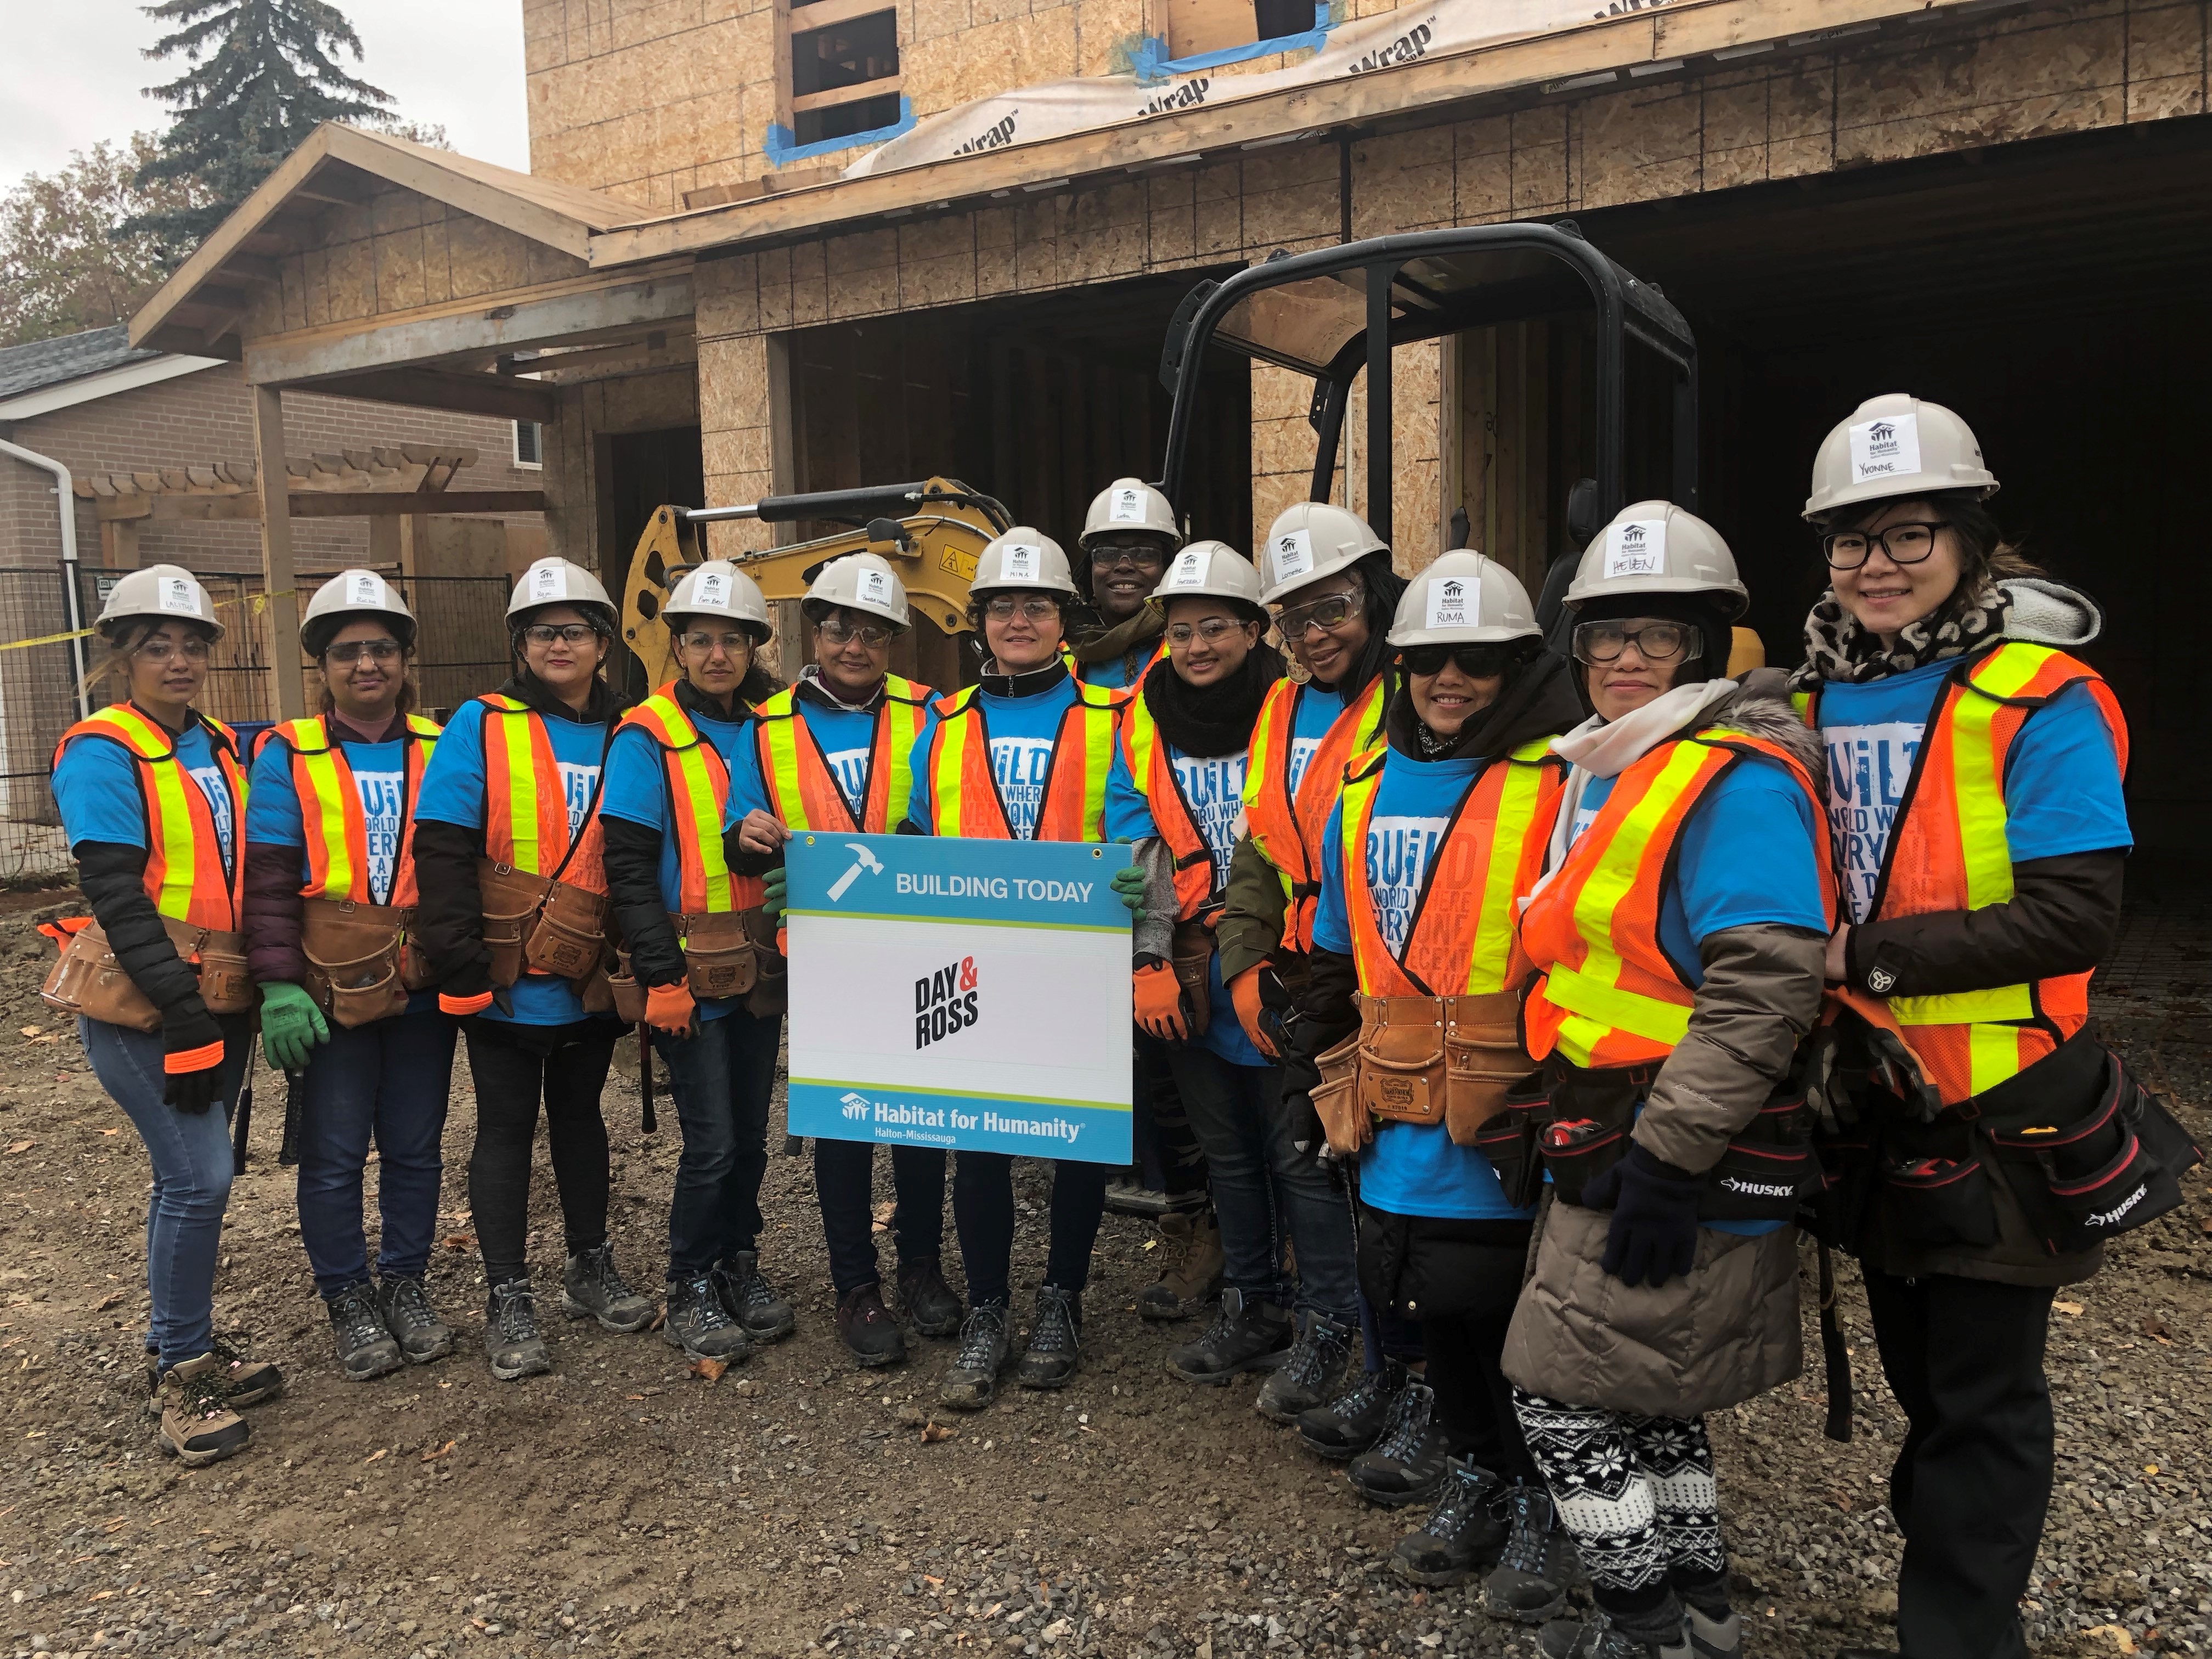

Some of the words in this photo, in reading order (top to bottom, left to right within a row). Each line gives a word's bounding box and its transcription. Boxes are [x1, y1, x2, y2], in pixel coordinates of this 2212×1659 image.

[1869, 441, 1898, 451] Habitat
[1859, 462, 1895, 476] YVONNE
[1282, 550, 1299, 560] Habitat
[1613, 556, 1655, 574] HELEN
[1436, 612, 1465, 624] RUMA
[365, 817, 396, 832] ORLD
[896, 873, 1008, 899] BUILDING
[1013, 879, 1093, 904] TODAY
[915, 991, 978, 1050] ROSS
[874, 1102, 945, 1128] Habitat
[950, 1108, 979, 1130] for
[874, 1127, 956, 1145] Halton-Mississauga
[1740, 1181, 1794, 1197] HUSKY
[2105, 1183, 2146, 1223] HUSKY
